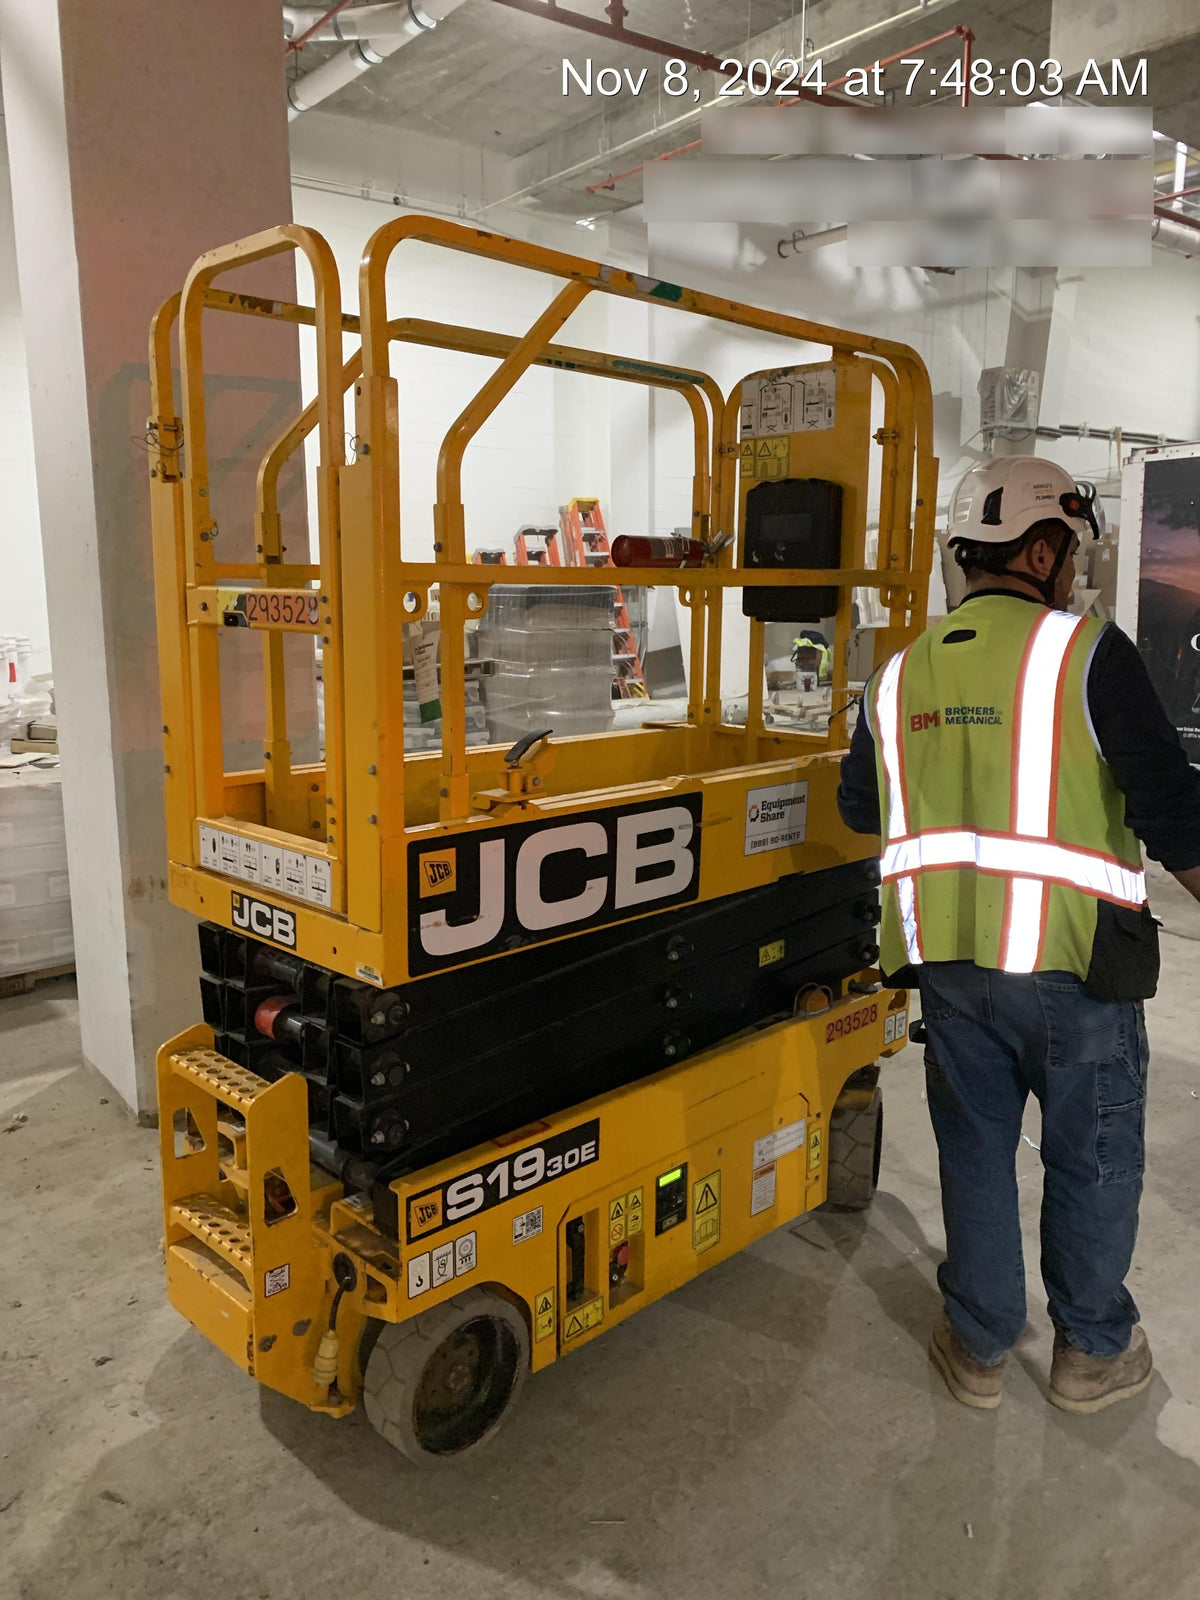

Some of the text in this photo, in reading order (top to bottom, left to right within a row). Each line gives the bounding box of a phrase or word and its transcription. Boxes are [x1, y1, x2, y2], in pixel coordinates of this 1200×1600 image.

[248, 594, 319, 625] 293528
[761, 794, 806, 812] Equipment
[760, 811, 785, 823] Share
[419, 806, 695, 956] JCB
[427, 862, 451, 885] JCB
[233, 897, 295, 946] JCB
[825, 1003, 878, 1043] 293528
[418, 1203, 438, 1225] JCB
